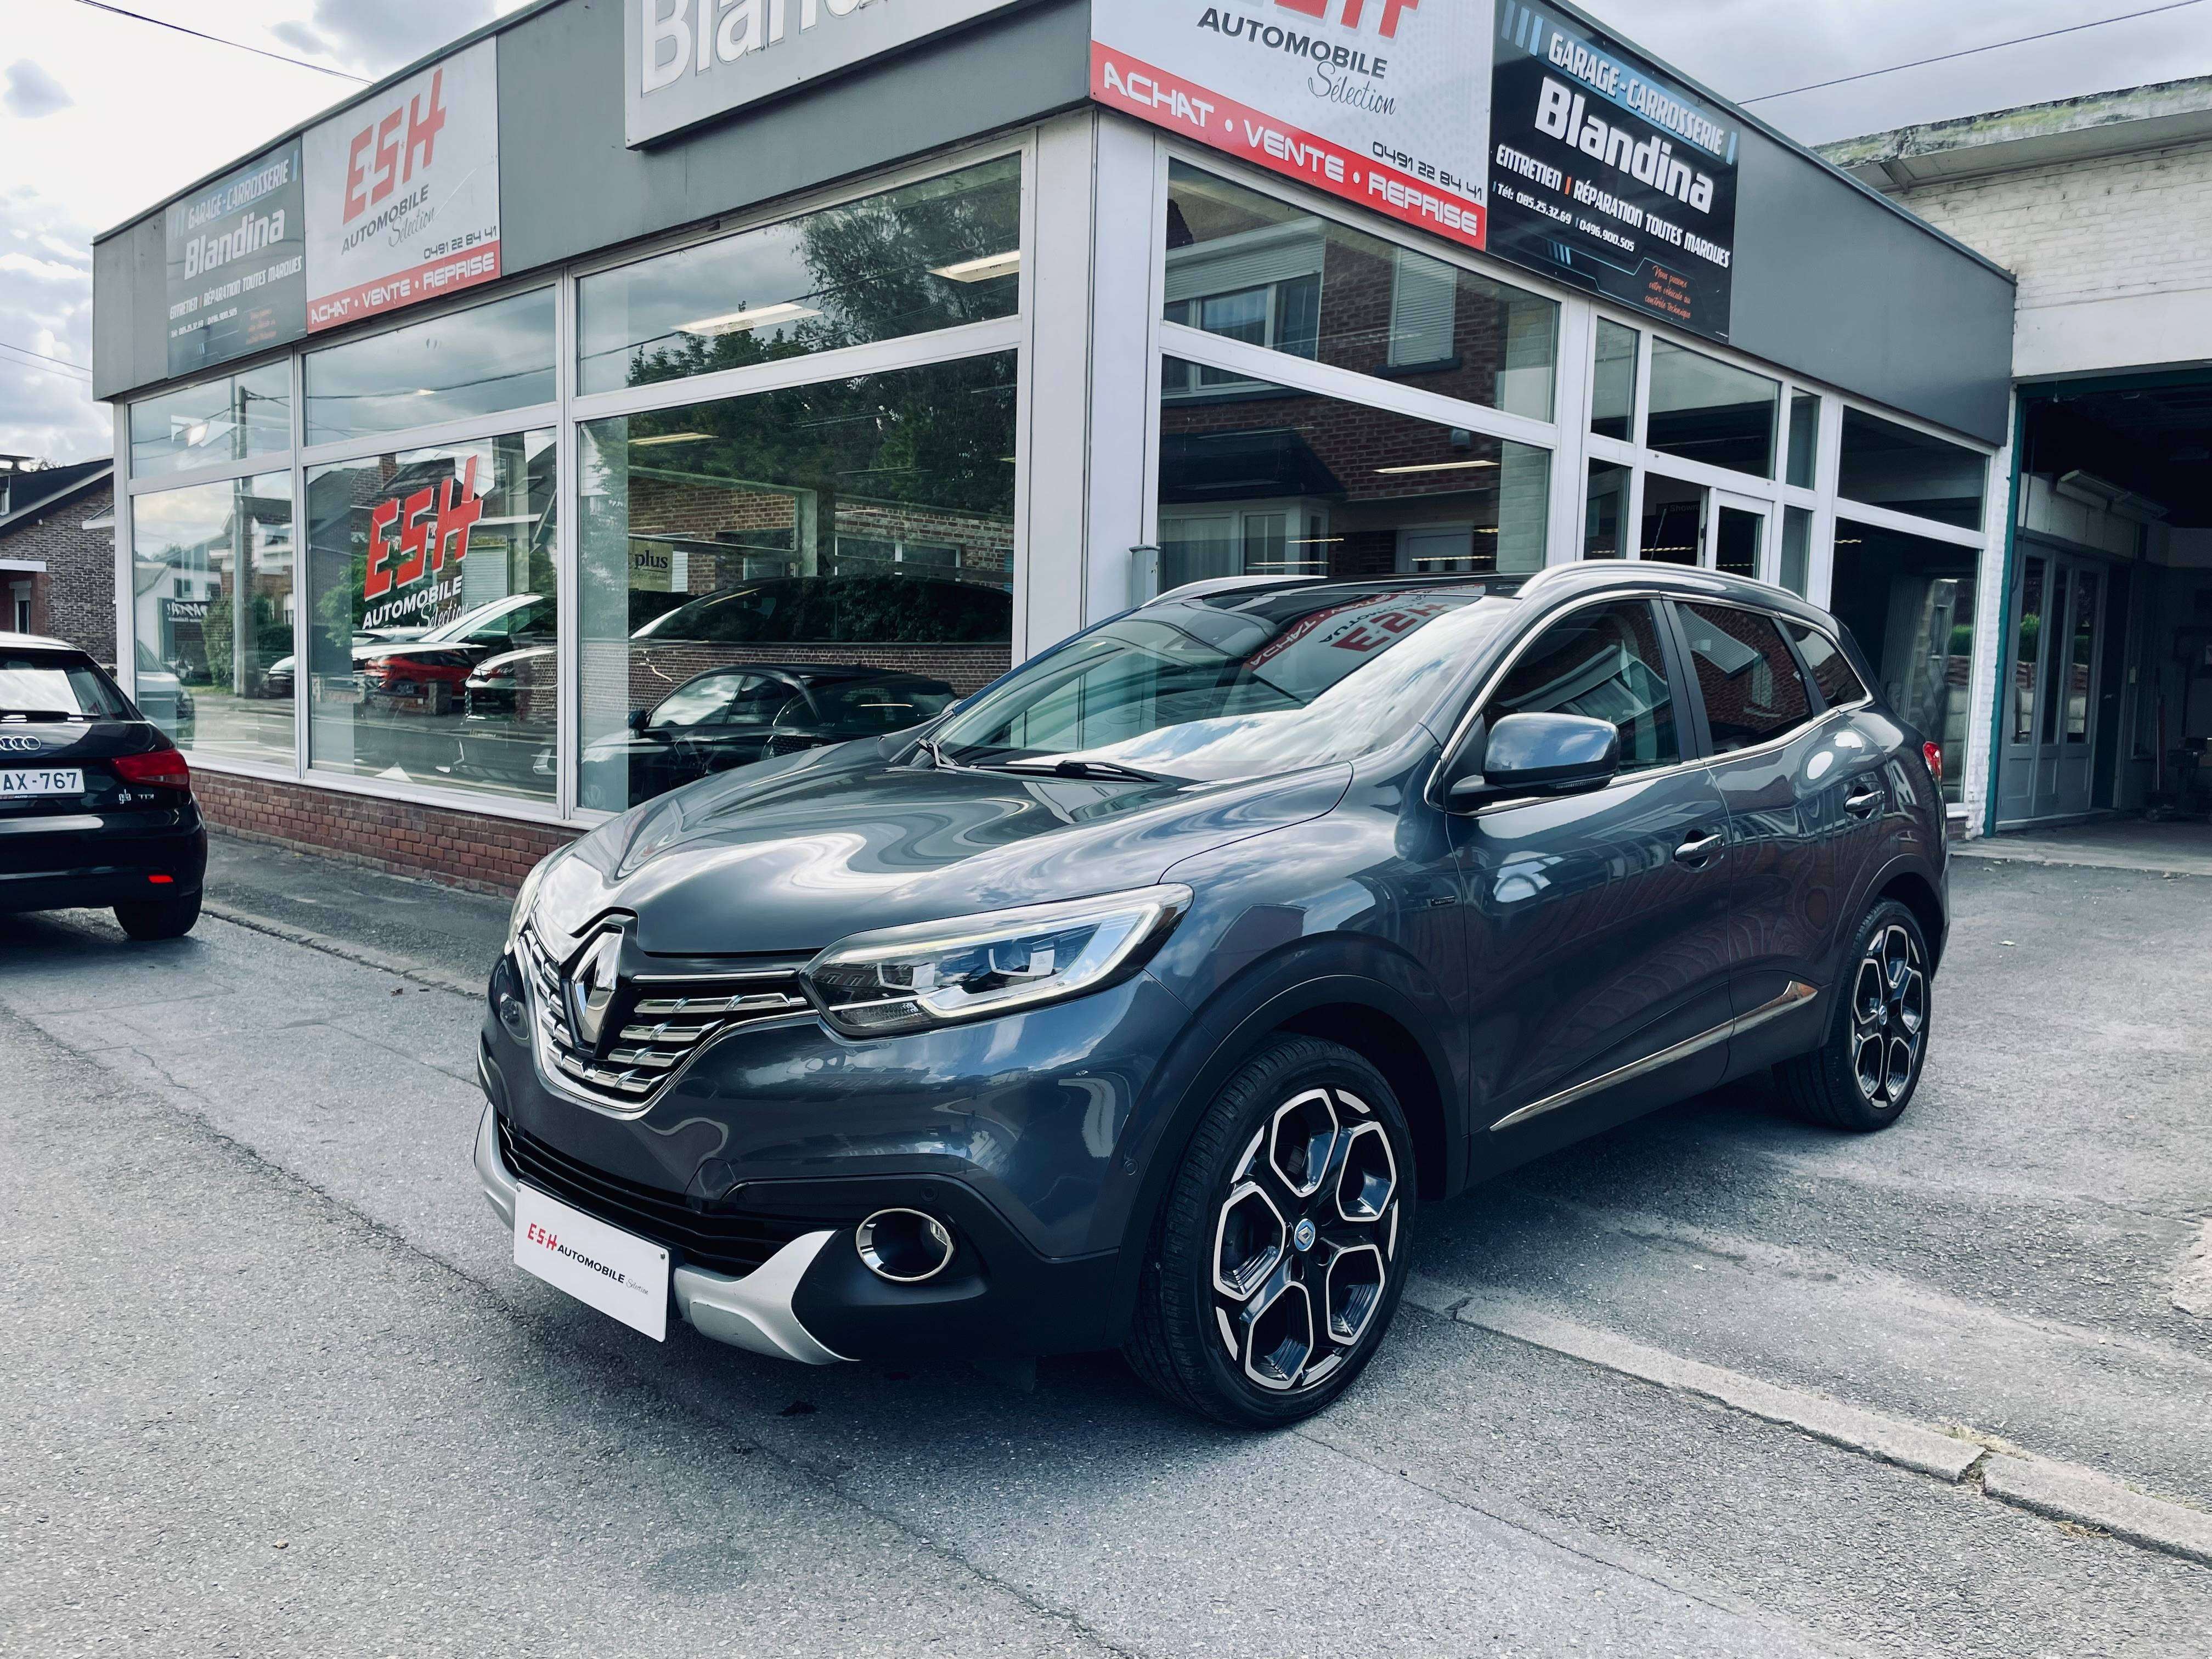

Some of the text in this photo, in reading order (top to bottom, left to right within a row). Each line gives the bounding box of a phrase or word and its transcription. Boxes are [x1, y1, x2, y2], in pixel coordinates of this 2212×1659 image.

[1197, 8, 1387, 81] AUTOMOBILE
[1308, 61, 1396, 115] Sélection
[343, 67, 447, 225] ESH
[1104, 62, 1477, 237] ACHAT VENTE REPRISE
[1373, 142, 1482, 201] 0491 22 84 41
[1534, 76, 1714, 214] Blandina
[341, 183, 430, 256] AUTOMOBILE
[1496, 143, 1730, 268] ENTRETIEN RÉPARATION TOUTES MARQUES
[1498, 183, 1635, 252] Tél: 085.25.32.69 0496.900.505
[184, 209, 285, 280] Blandina
[424, 225, 497, 259] 0491 22 84 41
[203, 279, 241, 307] RÉPARATION
[242, 269, 266, 292] TOUTES
[268, 255, 302, 283] MARQUES
[311, 251, 494, 325] ACHAT VENTE REPRISE
[364, 454, 483, 602] ESH
[635, 550, 668, 569] plus
[362, 575, 462, 630] AUTOMOBILE
[3, 772, 77, 791] AX-767
[557, 1244, 625, 1283] AUTOMOBILE
